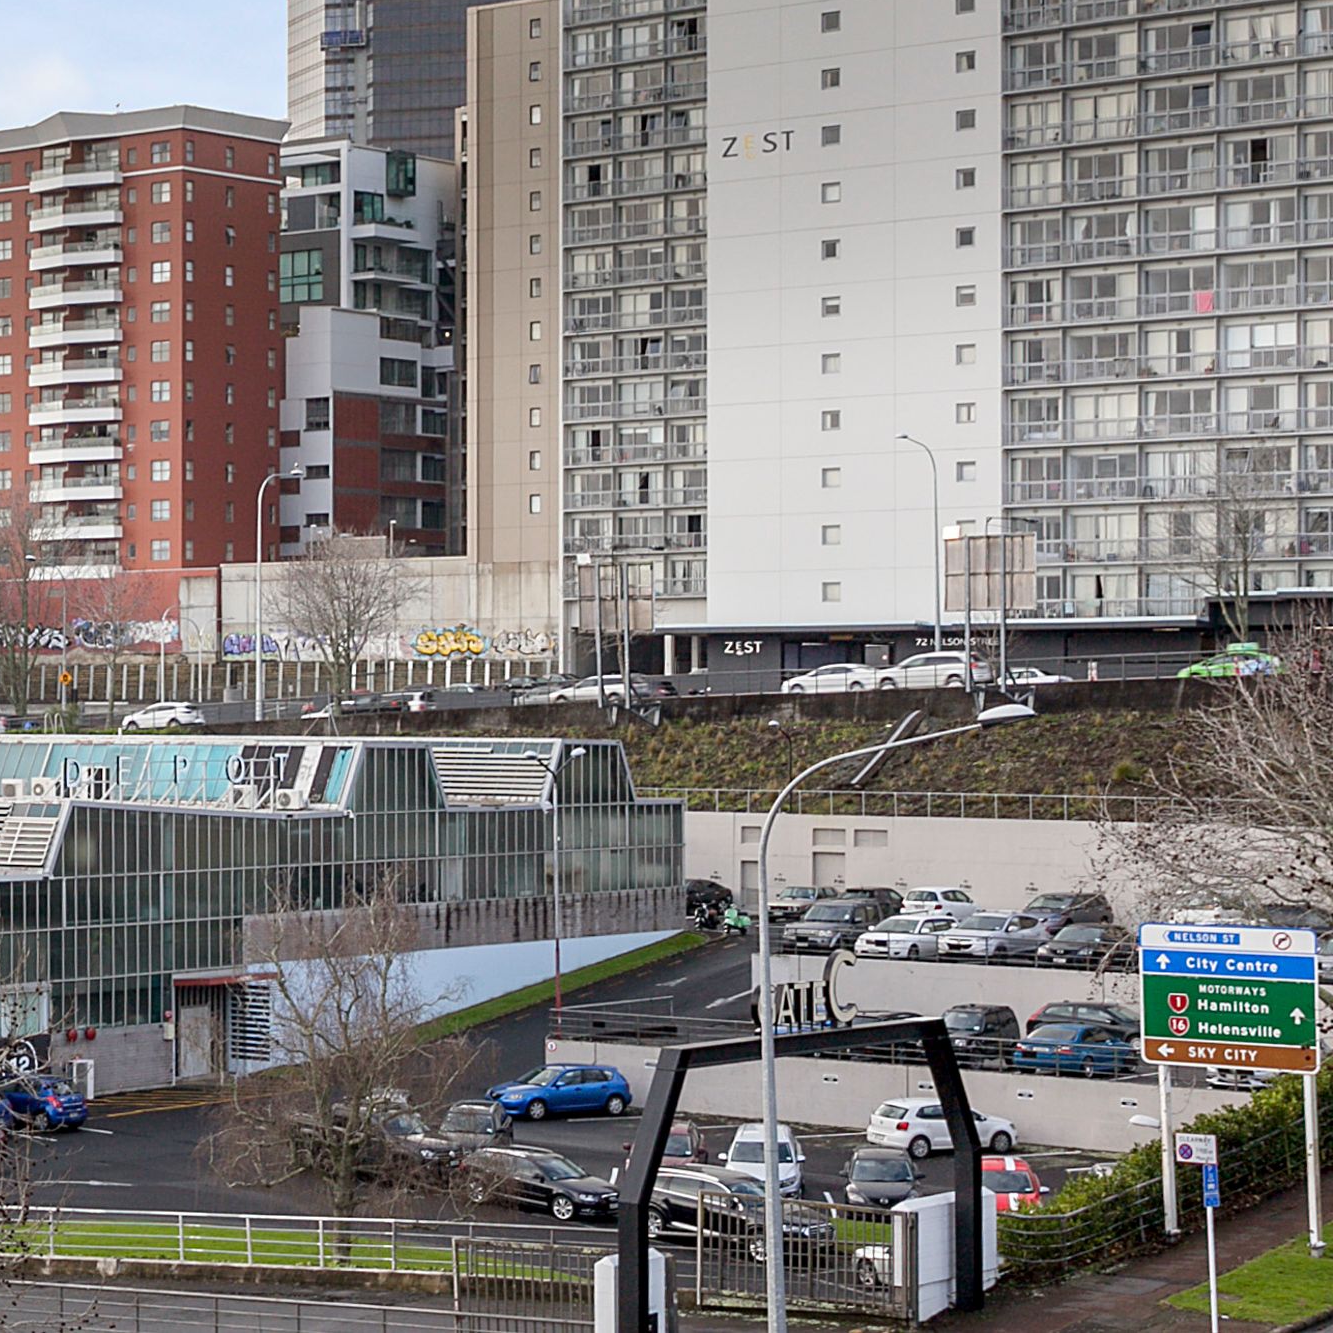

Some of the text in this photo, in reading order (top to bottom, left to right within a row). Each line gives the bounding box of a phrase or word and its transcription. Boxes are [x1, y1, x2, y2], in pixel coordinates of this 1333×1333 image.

[721, 129, 796, 161] ZEST
[724, 640, 763, 656] ZEST
[915, 637, 928, 647] 72
[64, 752, 290, 789] DEPOT
[1173, 932, 1235, 944] NELSON ST
[1185, 956, 1279, 973] City Centre
[823, 948, 858, 1023] C
[1198, 983, 1267, 997] MOTORWAYS
[1175, 996, 1270, 1015] 1 Hamilton
[1171, 1018, 1282, 1039] 16 Helensville
[1188, 1045, 1258, 1062] SKY CITY
